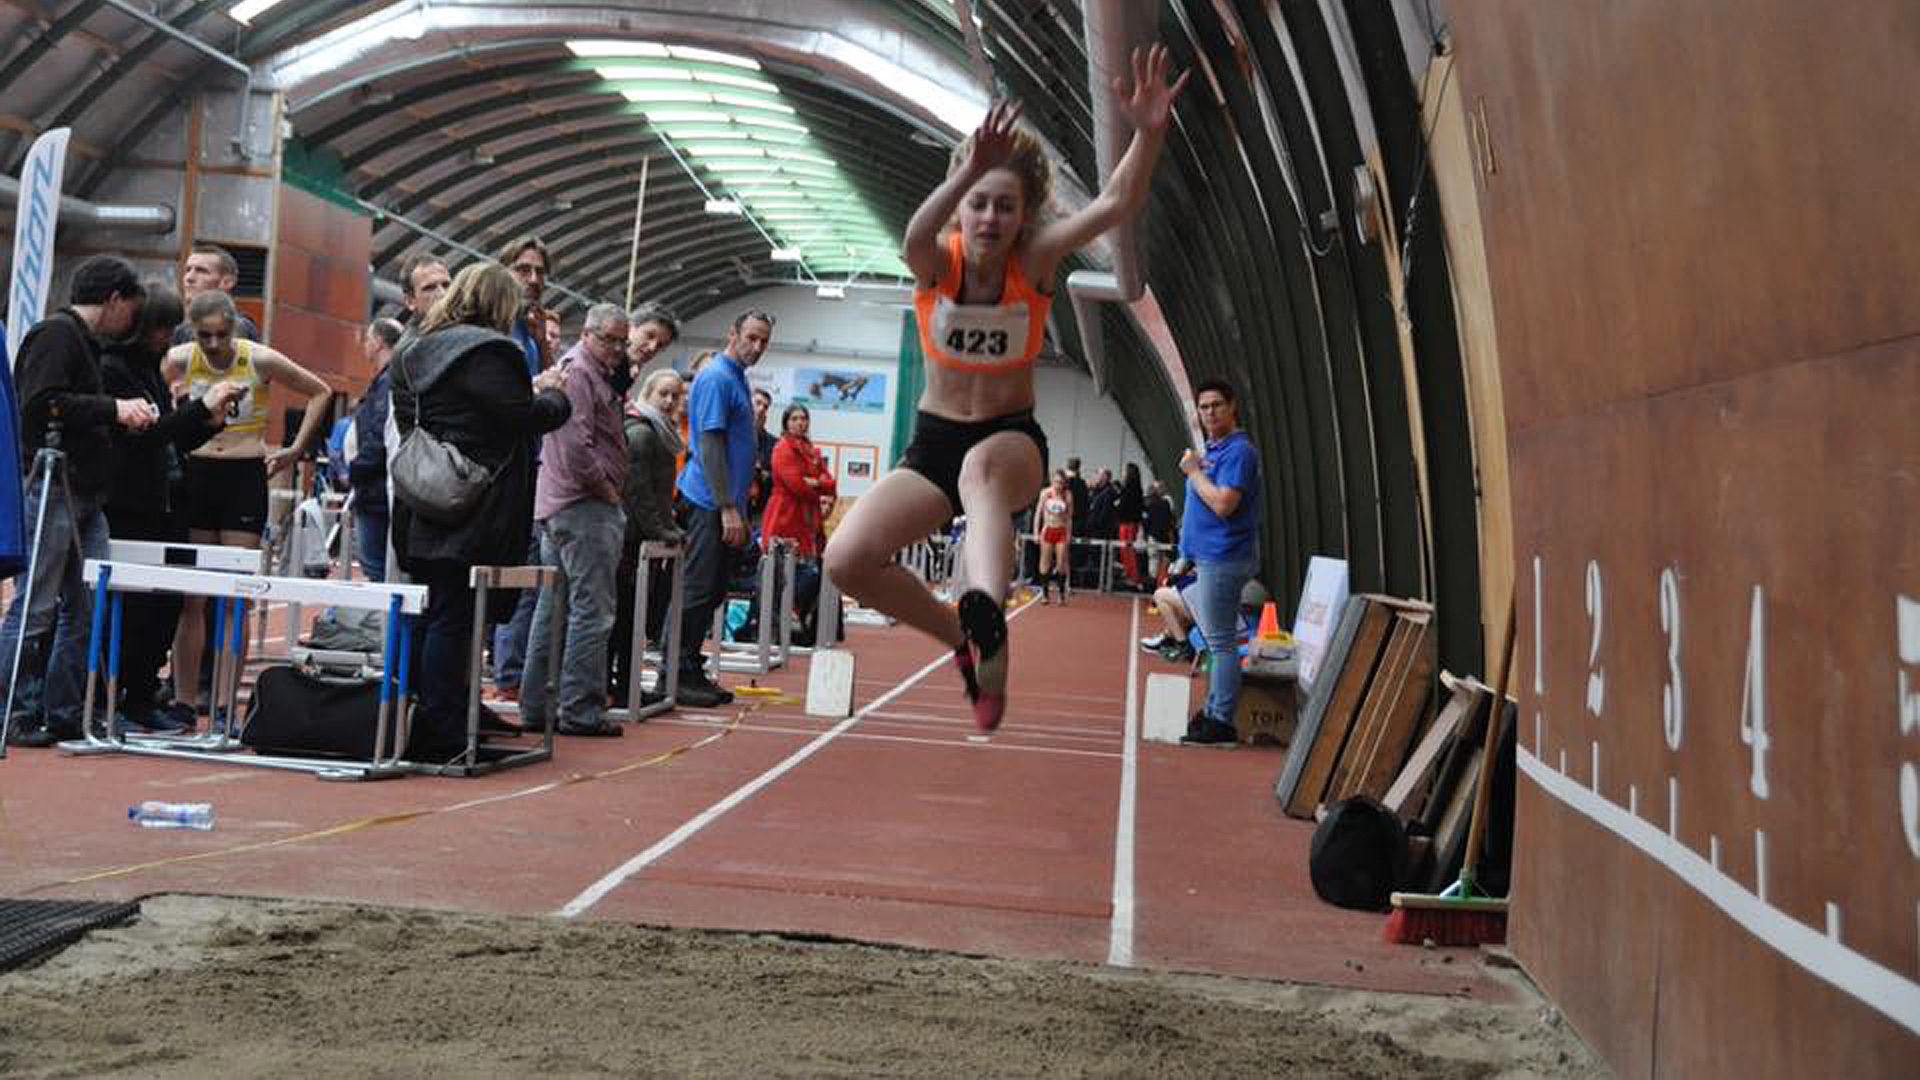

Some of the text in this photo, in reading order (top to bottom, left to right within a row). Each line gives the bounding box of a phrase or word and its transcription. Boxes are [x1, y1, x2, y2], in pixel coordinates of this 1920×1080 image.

[946, 328, 1009, 357] 423
[1533, 555, 1545, 695] 1
[1585, 558, 1605, 718] 2
[1659, 567, 1684, 752] 3
[1740, 584, 1771, 800] 4
[1249, 709, 1284, 723] TOP
